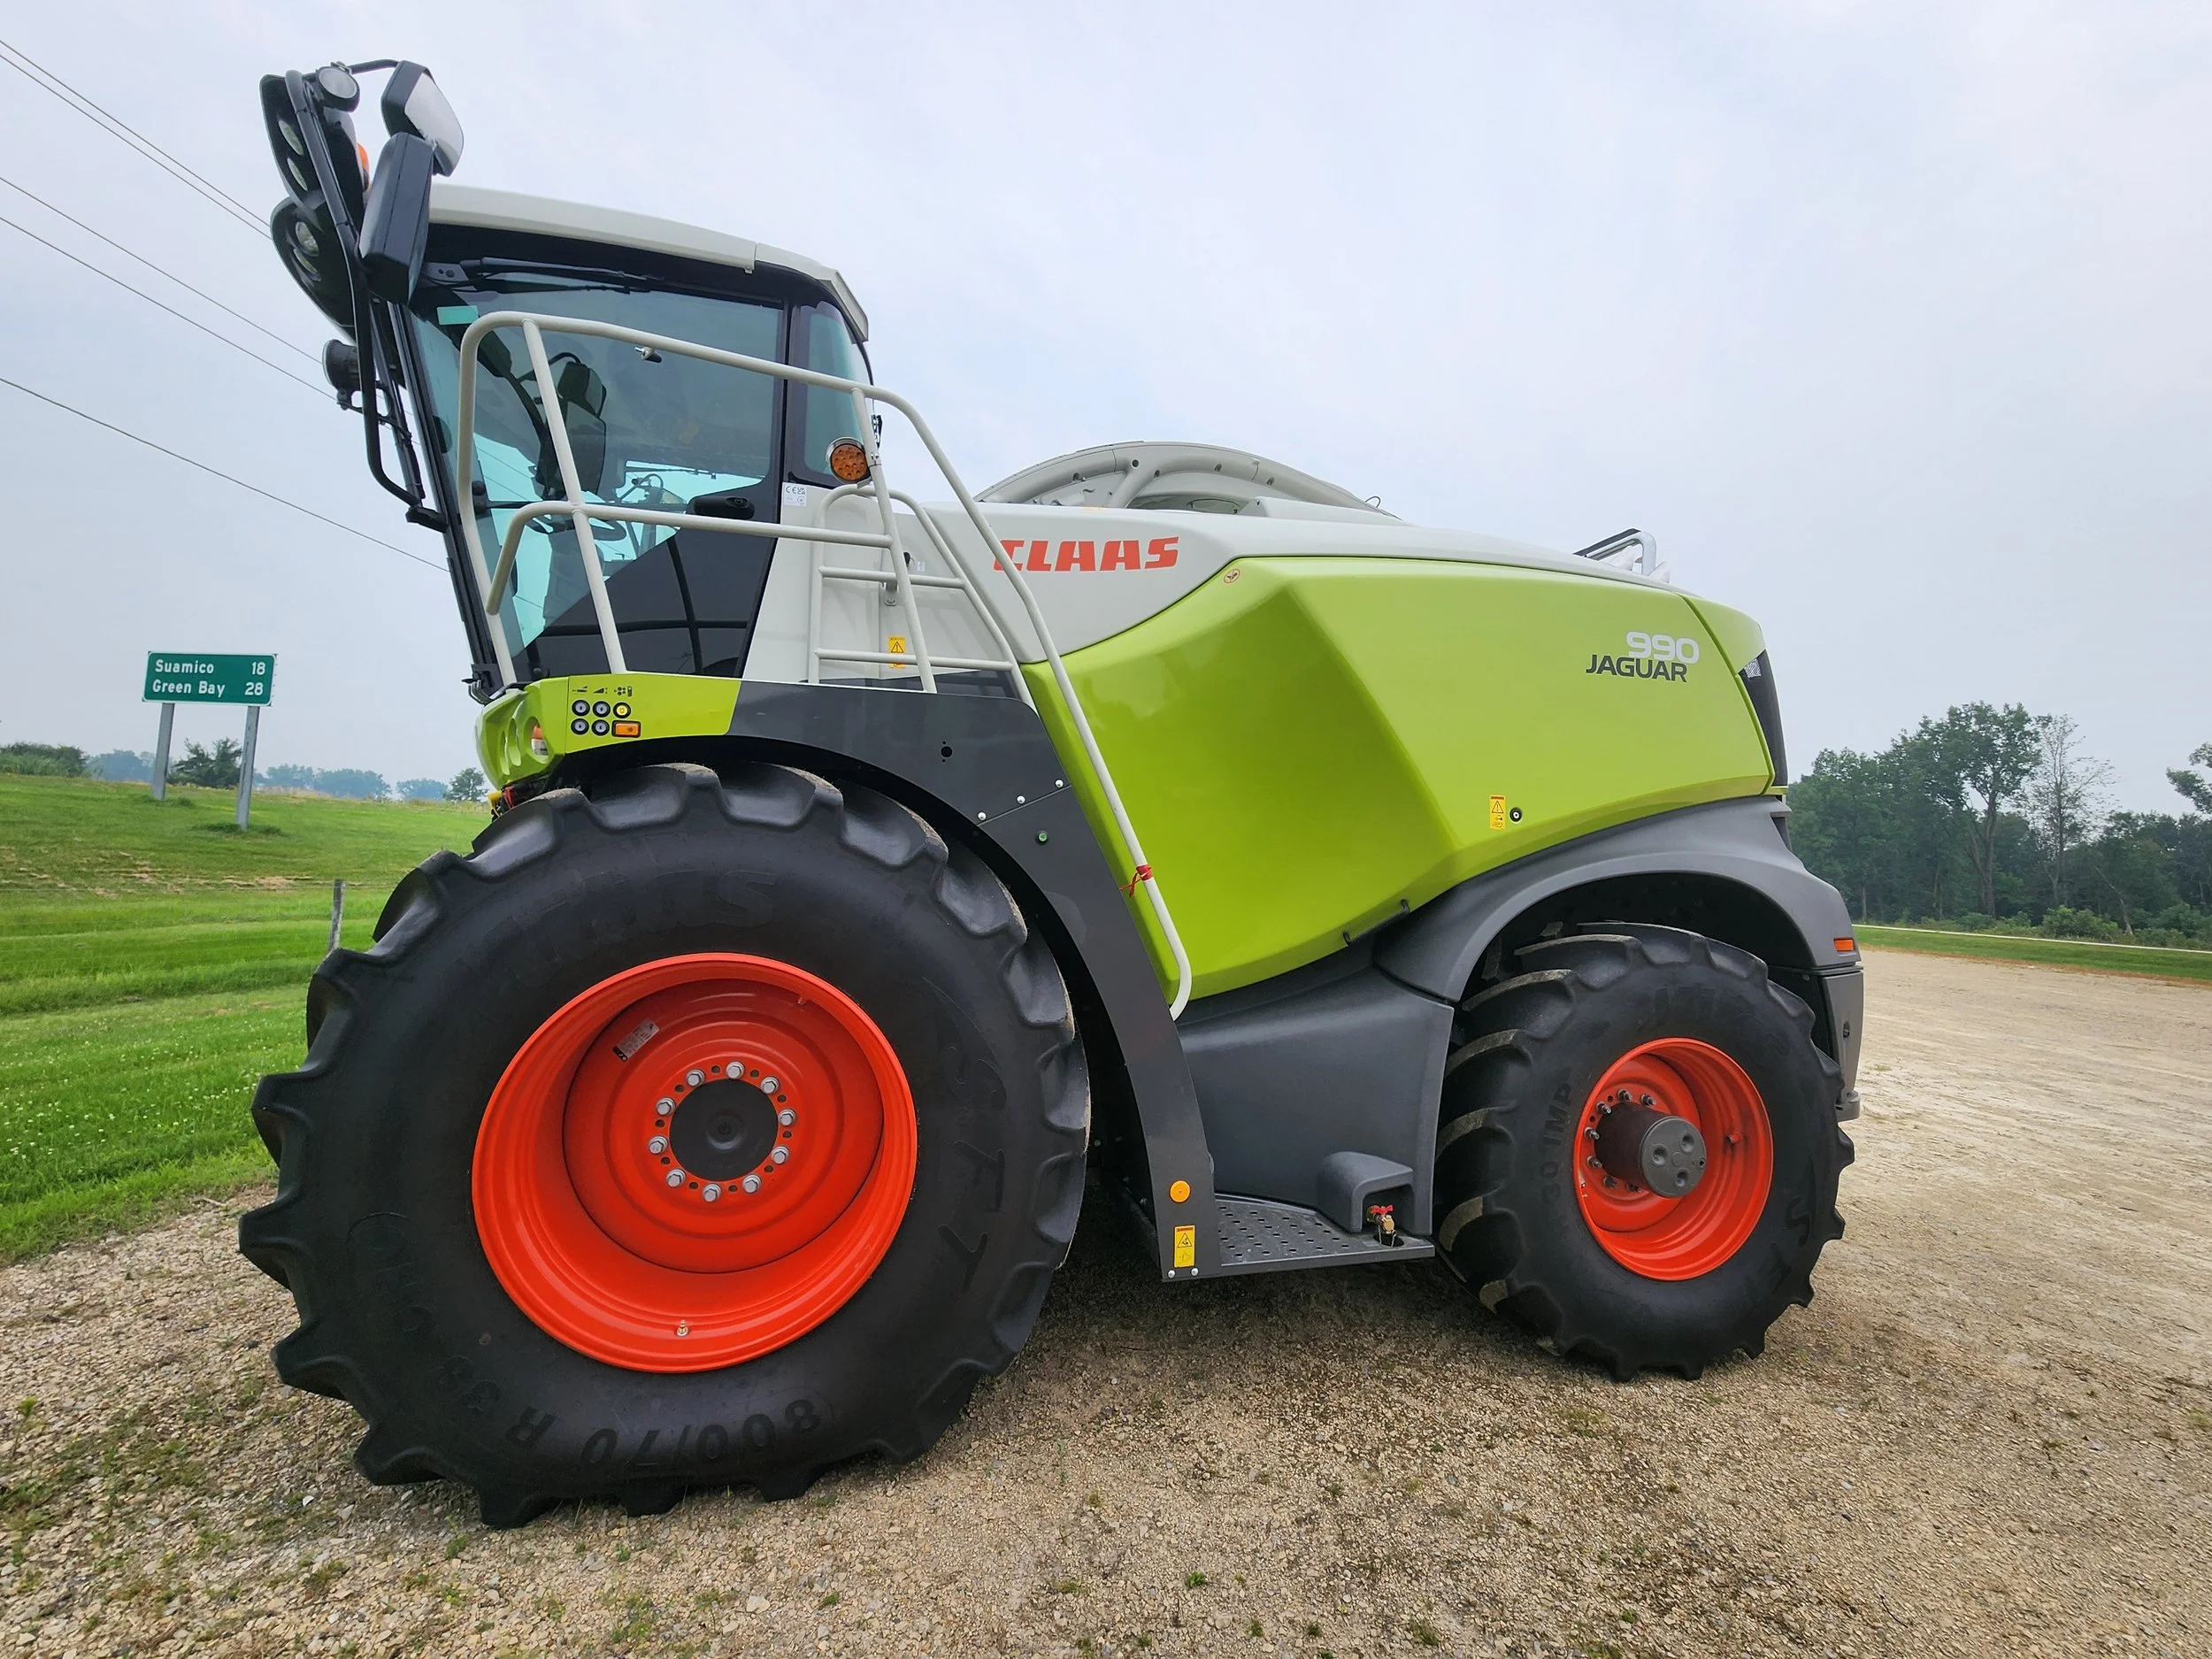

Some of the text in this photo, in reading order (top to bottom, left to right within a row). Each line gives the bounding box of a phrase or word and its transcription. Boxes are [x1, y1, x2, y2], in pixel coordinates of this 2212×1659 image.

[993, 536, 1179, 572] CLAAS
[1626, 631, 1700, 664] 990
[155, 659, 265, 675] Suamico 18
[1586, 655, 1686, 682] JAGUAR
[152, 680, 264, 697] Green Bay 28
